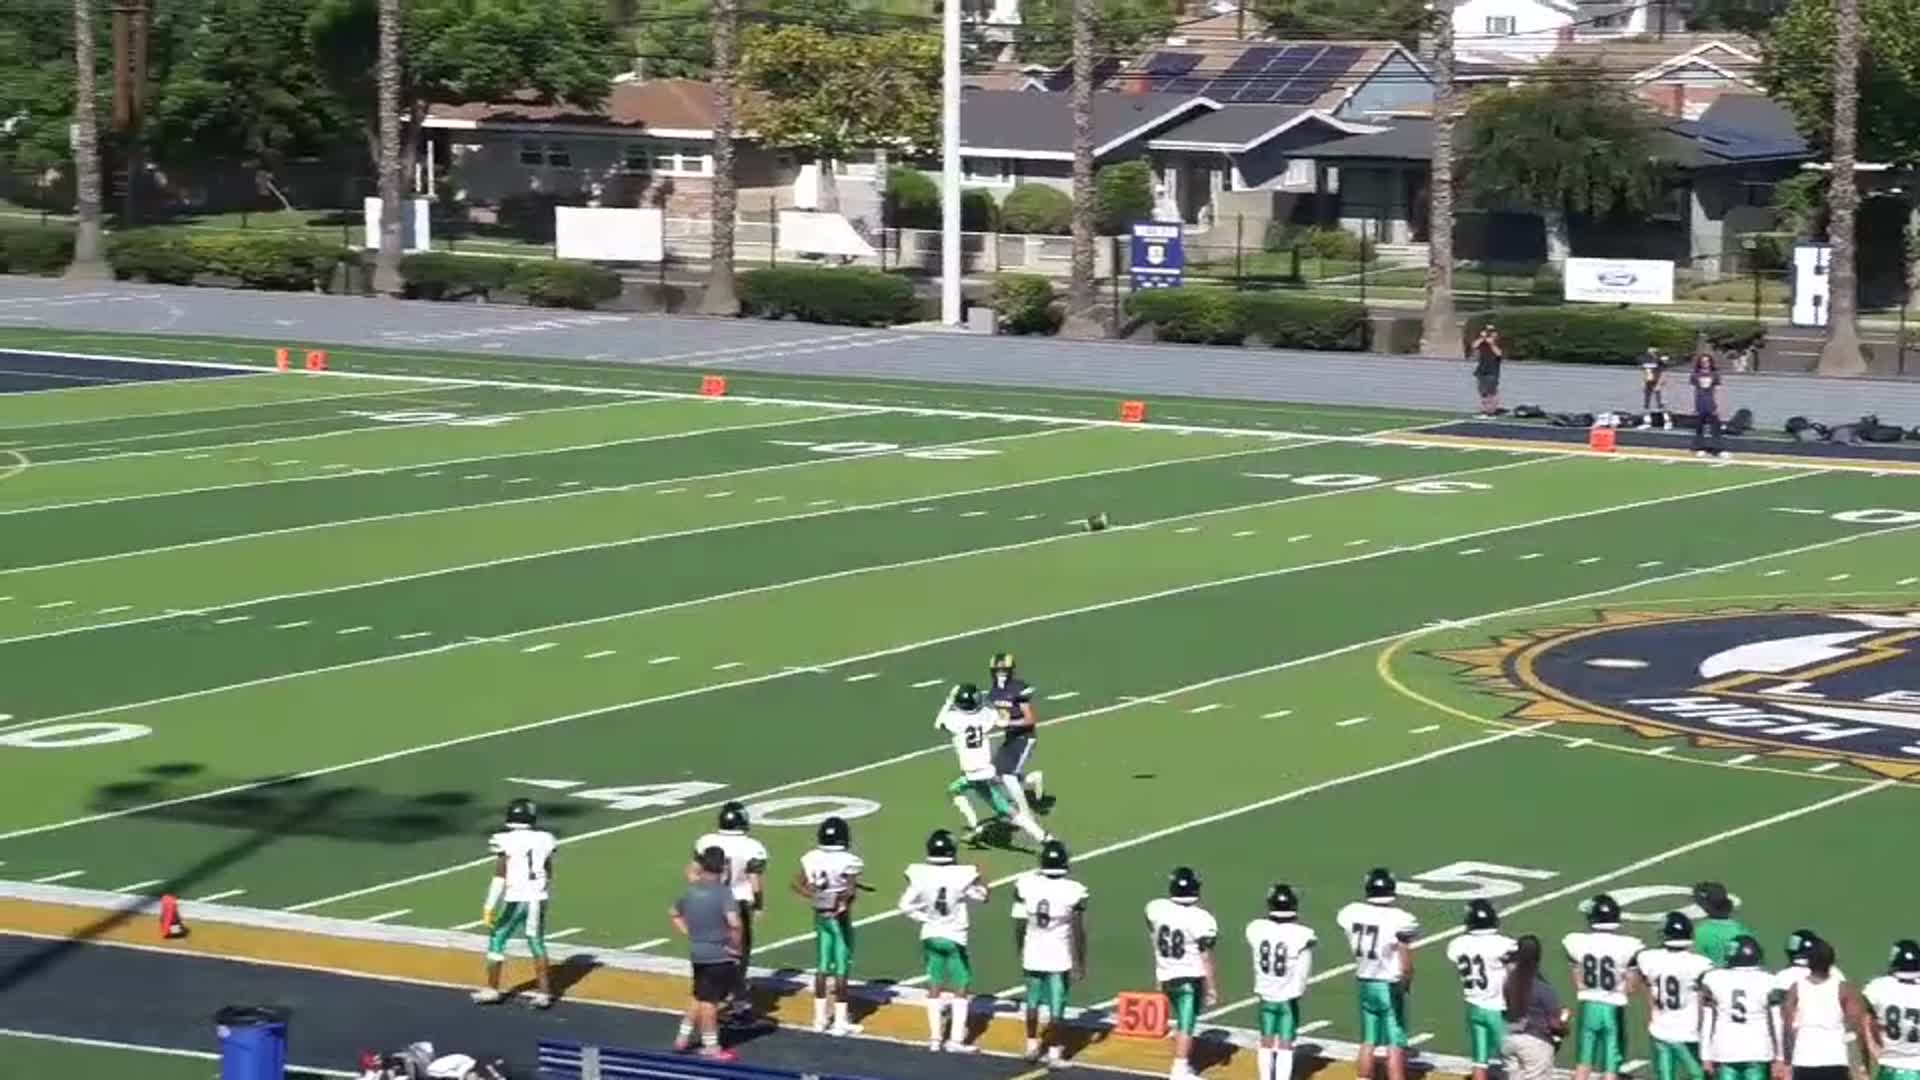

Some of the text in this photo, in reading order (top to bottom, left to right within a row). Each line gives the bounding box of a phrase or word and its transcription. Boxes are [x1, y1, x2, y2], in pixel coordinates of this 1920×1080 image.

[965, 725, 983, 749] 21
[1625, 696, 1880, 742] HIGH
[527, 849, 537, 880] 1
[934, 886, 948, 917] 4
[1158, 925, 1185, 959] 68
[1259, 939, 1287, 977] 88
[1352, 922, 1379, 960] 77
[1457, 953, 1488, 990] 23
[1583, 953, 1615, 991] 86
[1655, 974, 1680, 1011] 19
[1731, 989, 1747, 1024] 5
[1124, 998, 1158, 1031] 50
